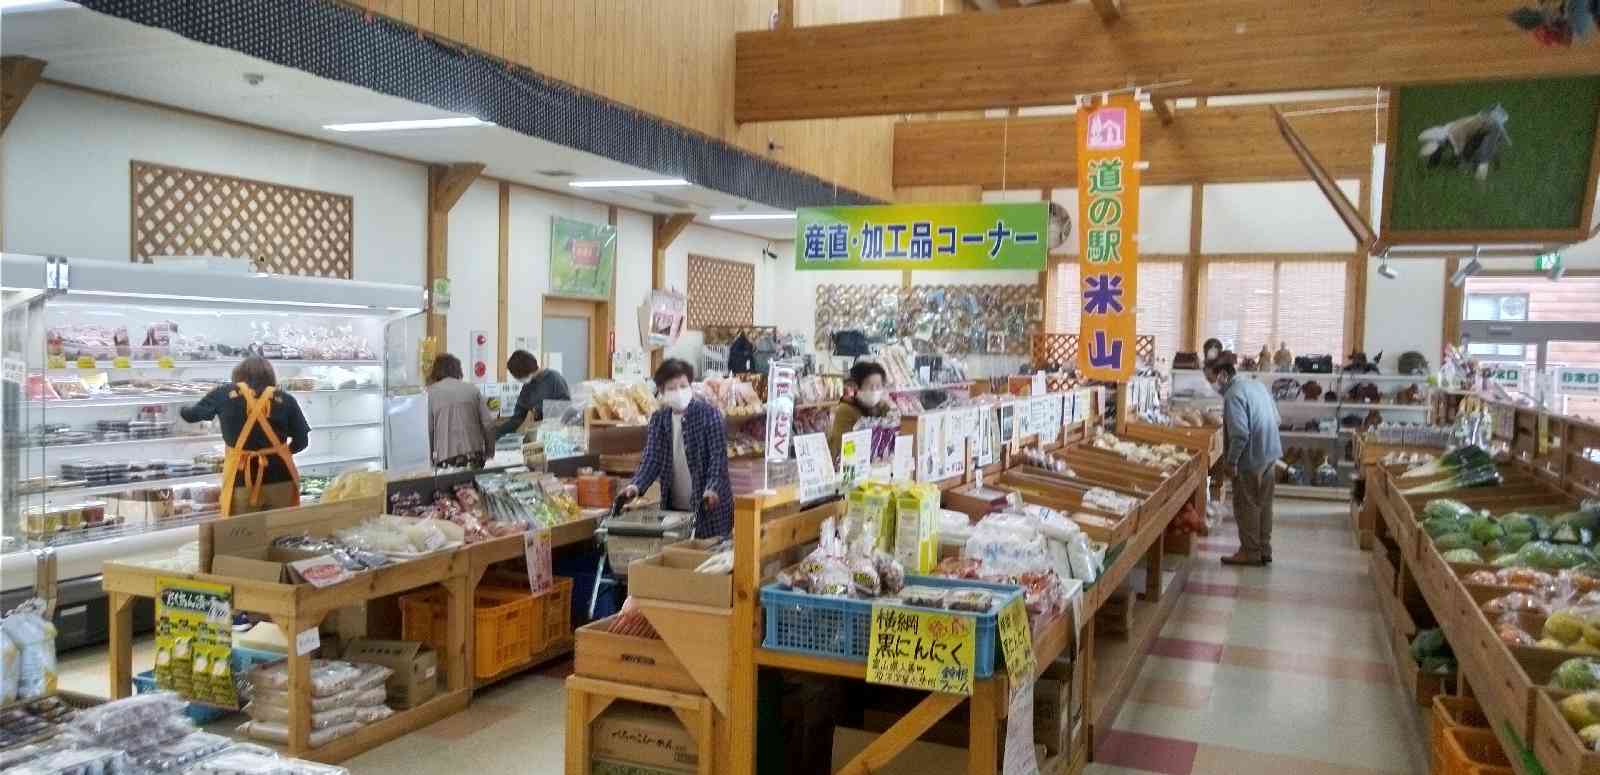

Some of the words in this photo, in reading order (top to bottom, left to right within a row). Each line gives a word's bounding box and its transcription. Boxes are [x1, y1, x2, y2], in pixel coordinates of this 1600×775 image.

[804, 221, 1039, 262] 産直・加工品コーナー
[1087, 159, 1123, 264] 道の駅
[1083, 274, 1124, 370] 米山
[875, 633, 963, 666] 黒にんにく
